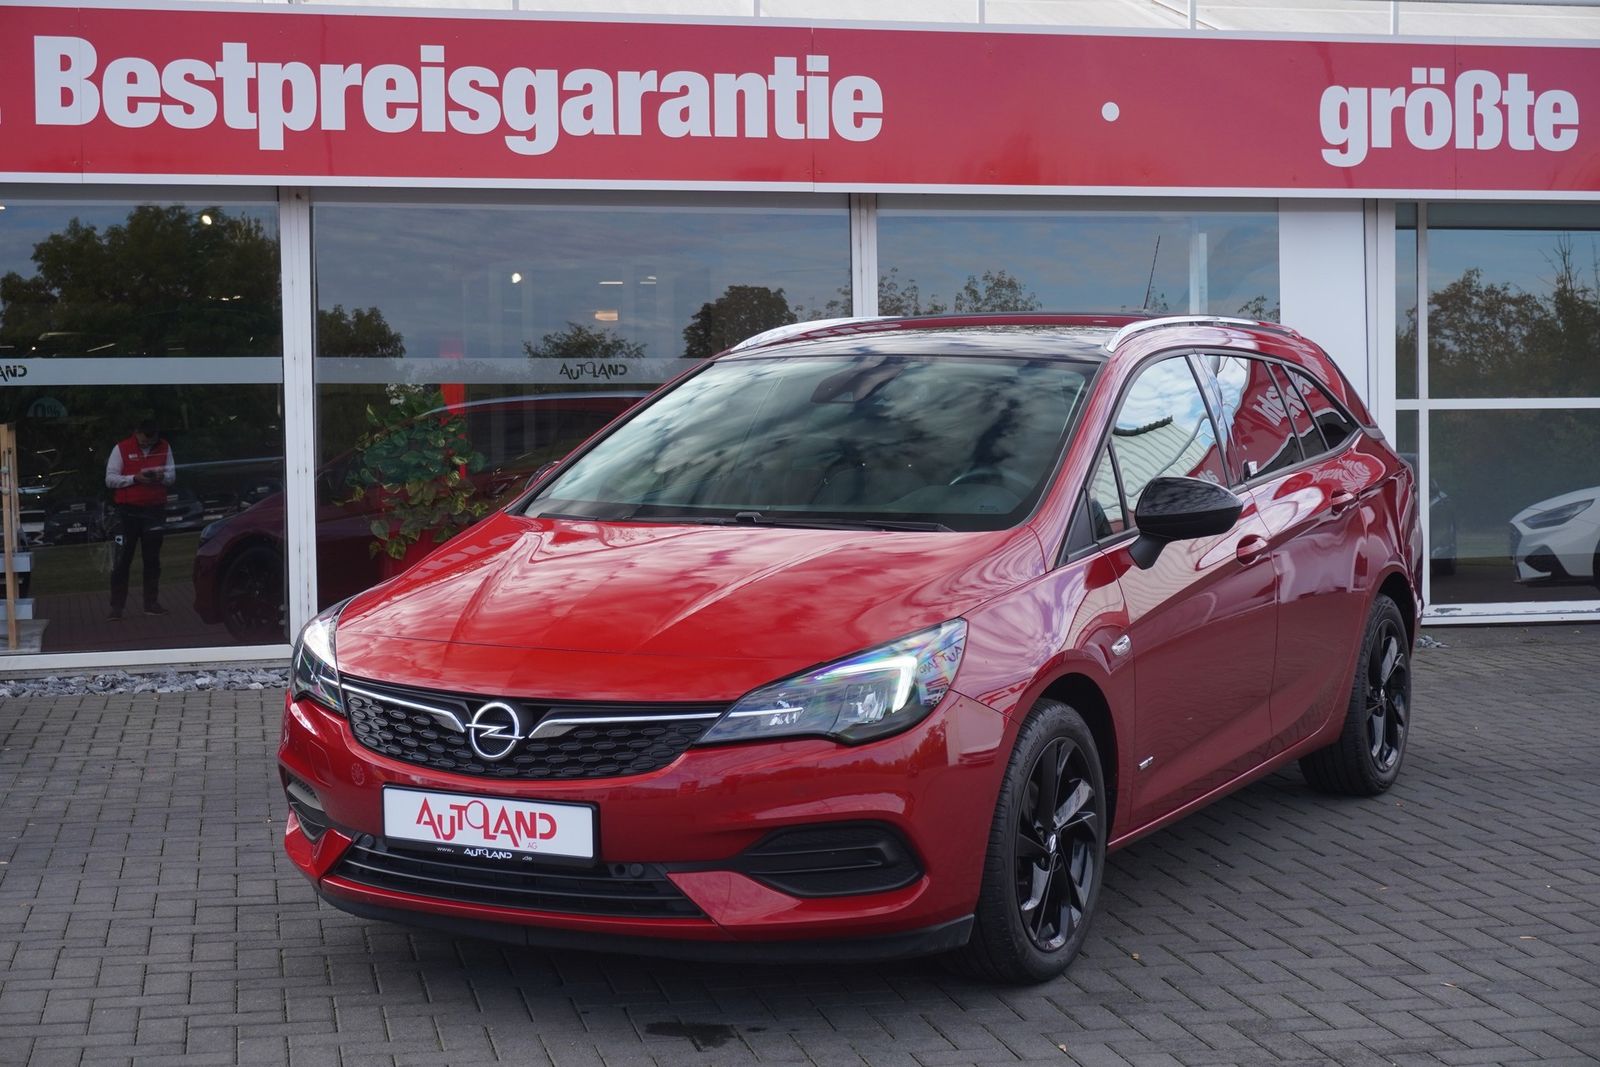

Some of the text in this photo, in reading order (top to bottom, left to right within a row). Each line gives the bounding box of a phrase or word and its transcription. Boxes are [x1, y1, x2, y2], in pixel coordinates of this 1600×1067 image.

[34, 36, 883, 156] Bestpreisgarantie
[1319, 67, 1580, 168] größte
[559, 362, 628, 380] AUTOLAND
[416, 797, 557, 848] AUTOLAND
[463, 847, 513, 860] AUTOLAND
[527, 841, 538, 850] AG
